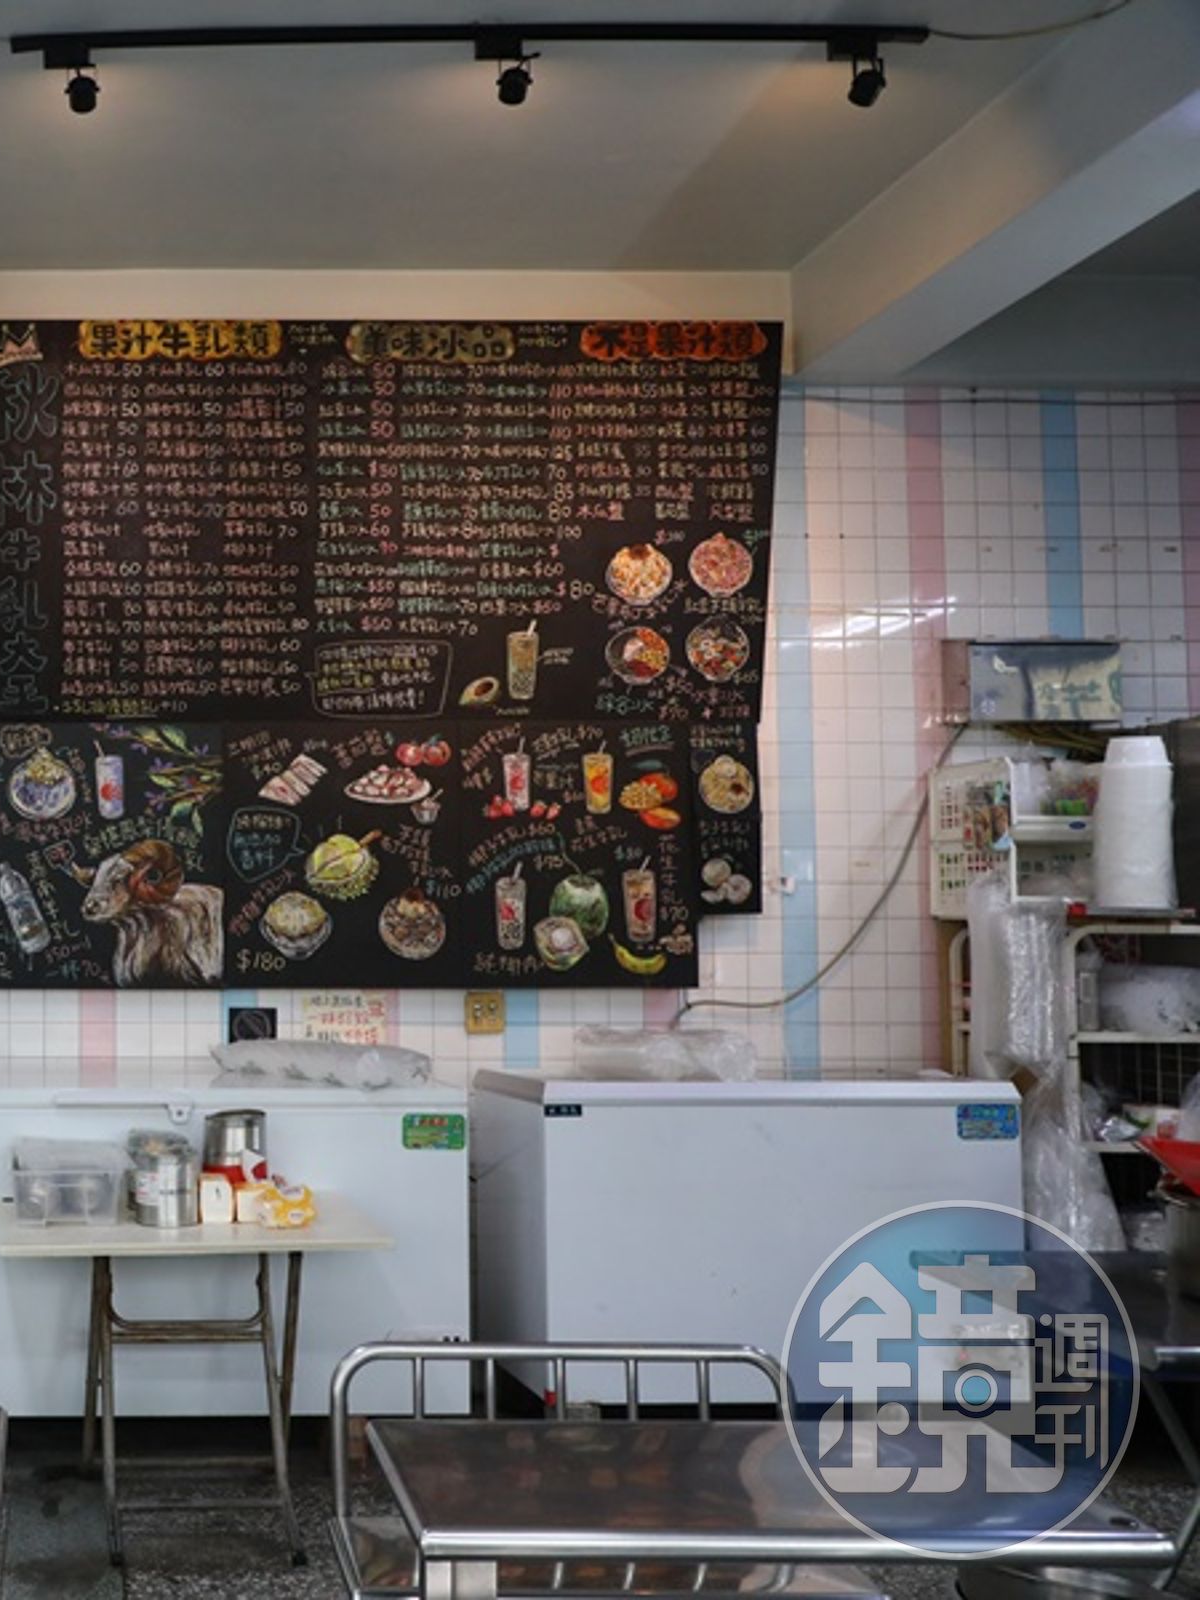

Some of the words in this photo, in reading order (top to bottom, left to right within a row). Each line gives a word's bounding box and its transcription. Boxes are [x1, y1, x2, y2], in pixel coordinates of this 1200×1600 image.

[90, 321, 269, 355] 果汁牛乳類
[373, 381, 397, 398] 50
[369, 421, 395, 439] 50
[235, 948, 287, 973] $180
